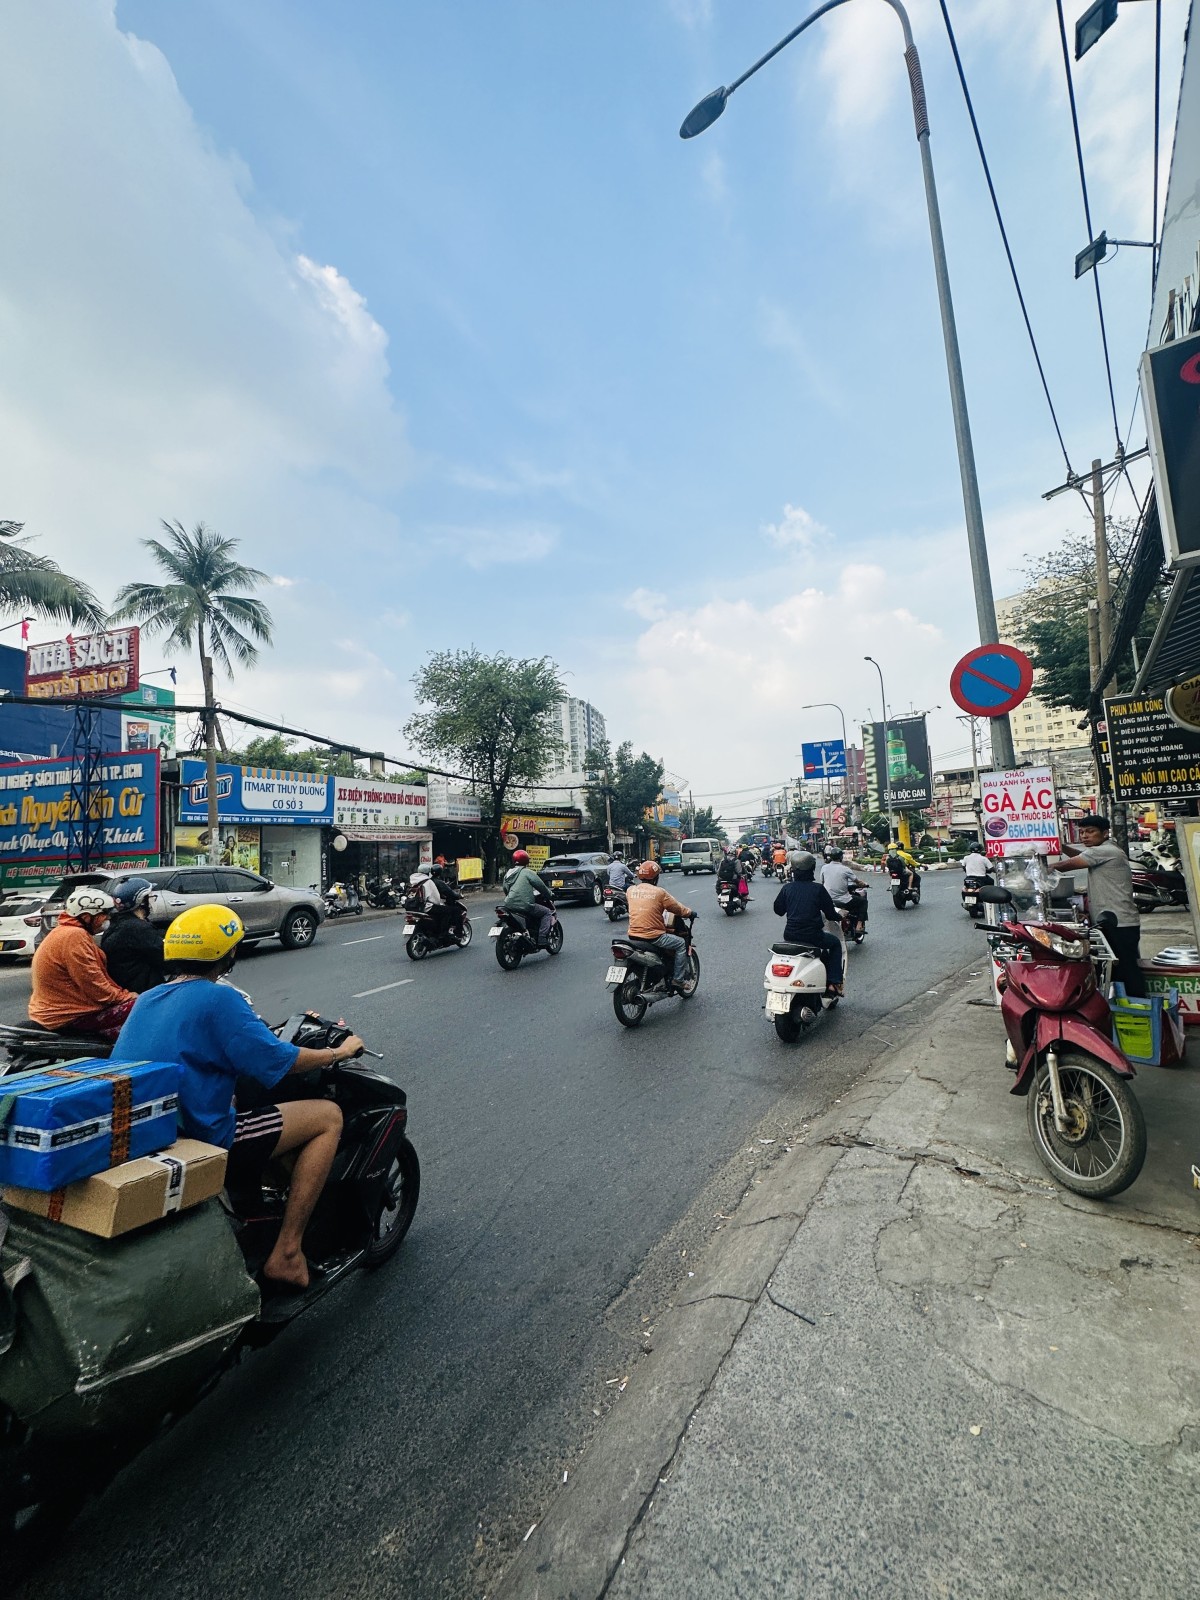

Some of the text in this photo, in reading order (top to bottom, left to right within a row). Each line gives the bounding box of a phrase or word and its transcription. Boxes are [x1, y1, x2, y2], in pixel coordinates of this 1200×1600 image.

[74, 632, 131, 668] SÁCH
[1158, 770, 1168, 784] MI
[1170, 768, 1188, 782] CAO
[244, 781, 275, 793] ITMART
[1120, 788, 1132, 796] ĐT
[338, 788, 348, 800] XE
[912, 788, 926, 799] GAN
[984, 785, 1052, 813] GÀ ÁC
[298, 801, 304, 810] 3
[102, 826, 145, 844] Khách
